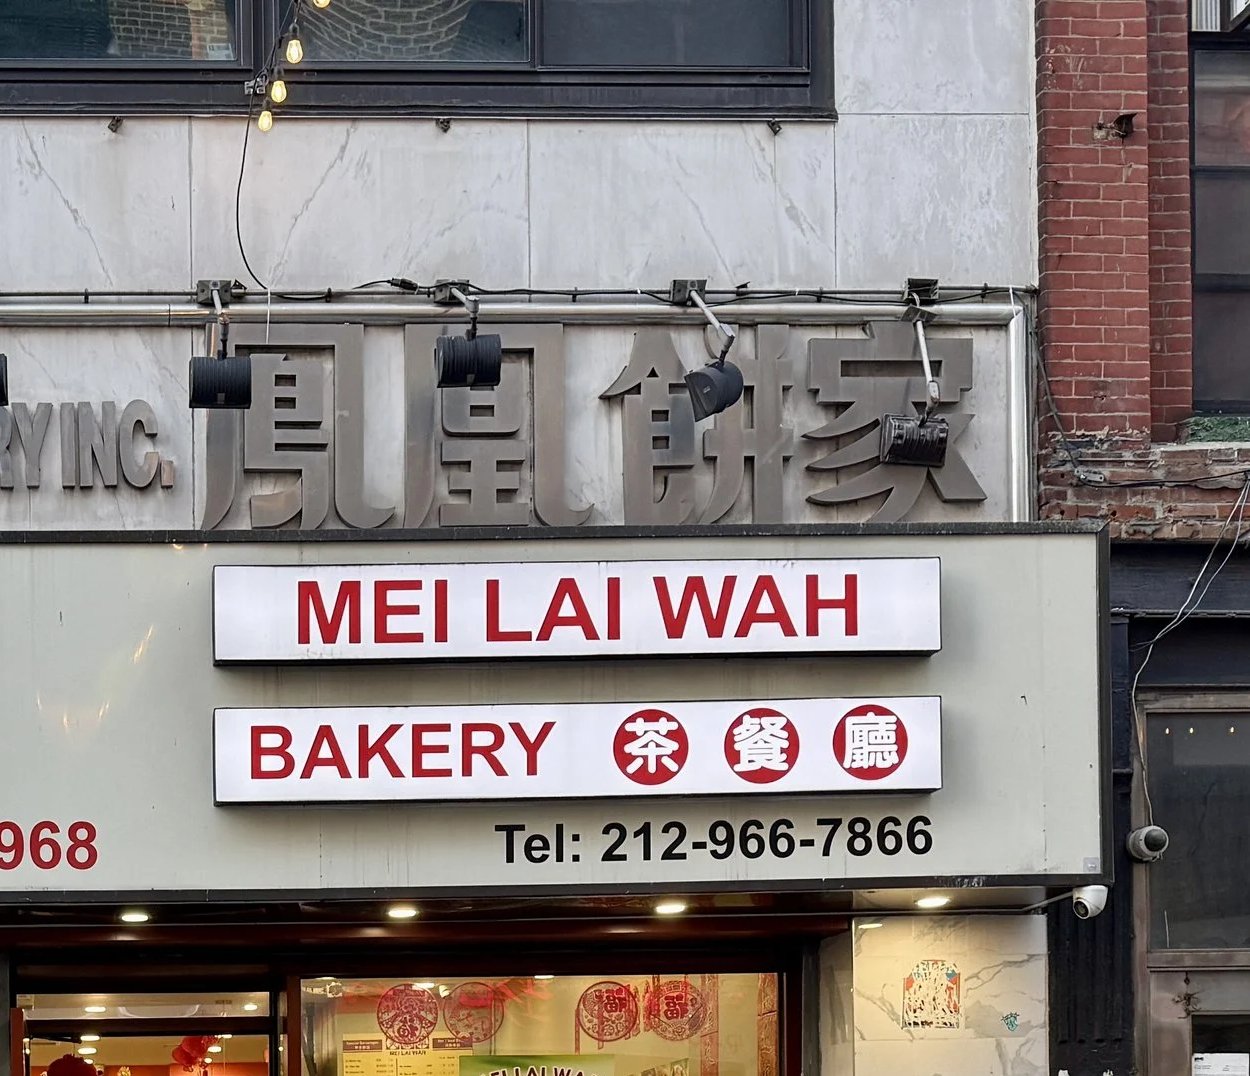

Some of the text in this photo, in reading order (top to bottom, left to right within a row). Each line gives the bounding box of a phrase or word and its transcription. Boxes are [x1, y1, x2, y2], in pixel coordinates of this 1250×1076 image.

[60, 399, 175, 489] INC.
[297, 574, 859, 645] MEI LAI WAH
[250, 721, 555, 780] BAKERY
[624, 711, 901, 774] 茶餐廳
[494, 815, 934, 864] Tel: 212-966-7866
